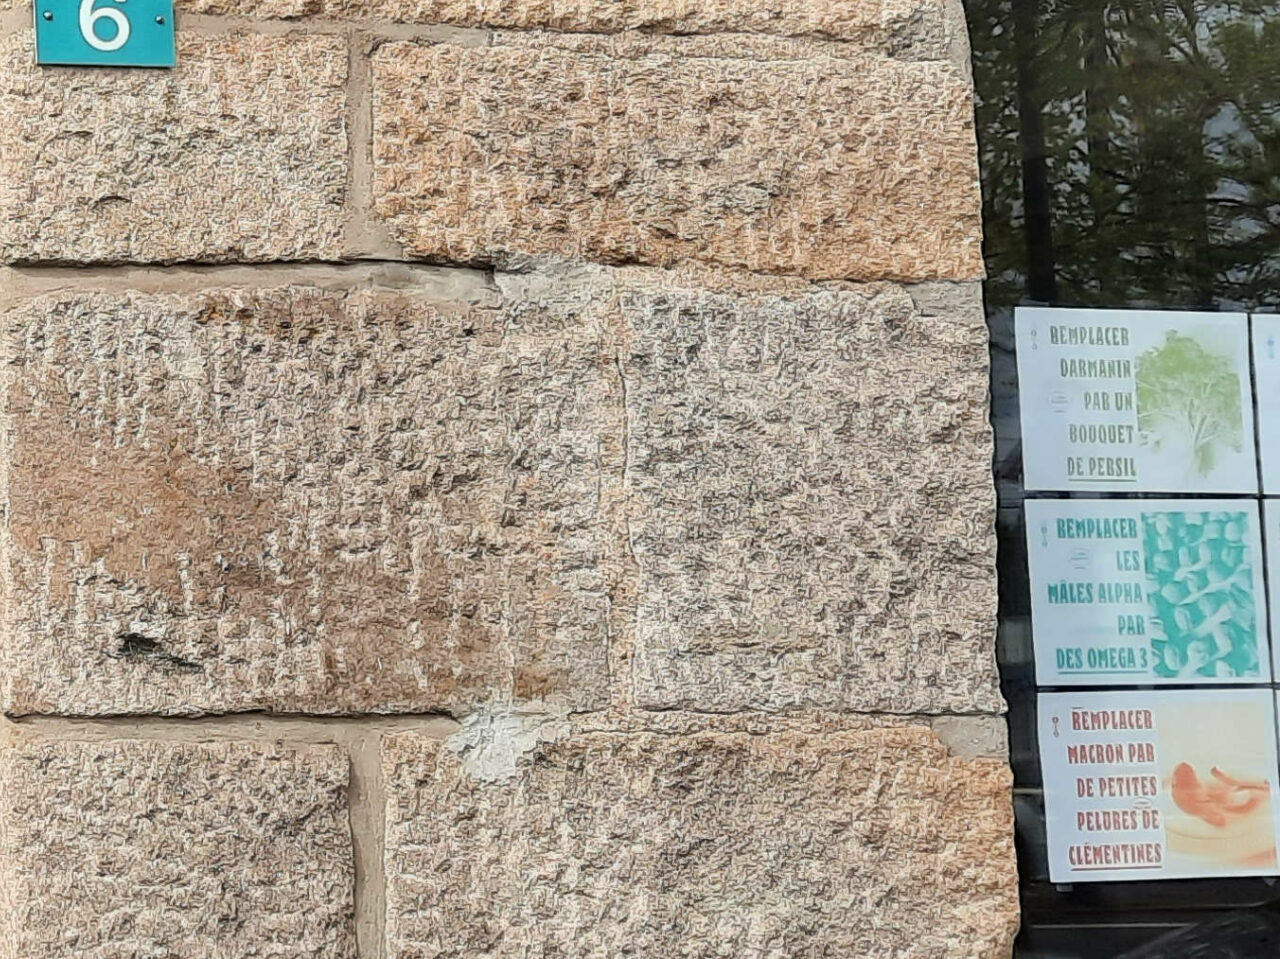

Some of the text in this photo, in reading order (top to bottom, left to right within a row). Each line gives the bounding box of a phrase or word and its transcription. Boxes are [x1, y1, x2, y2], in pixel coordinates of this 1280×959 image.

[1050, 325, 1129, 346] REMPLACER
[1060, 358, 1131, 378] DARMANIN
[1084, 392, 1133, 411] PAR UN
[1069, 424, 1134, 444] BOUQUET
[1067, 457, 1136, 477] DE PERSIL
[1056, 518, 1137, 539] REMPLACER
[1116, 550, 1140, 571] LES
[1047, 580, 1143, 604] MÂLES ALPHA
[1117, 615, 1145, 635] PAR
[1056, 648, 1148, 669] DES OMEGA 3
[1071, 709, 1153, 730] REMPLACER
[1067, 742, 1155, 764] MACRON PAR
[1076, 776, 1157, 798] DE PETITES
[1077, 809, 1160, 831] PELURES DE
[1069, 842, 1162, 866] CLÉMENTINES
